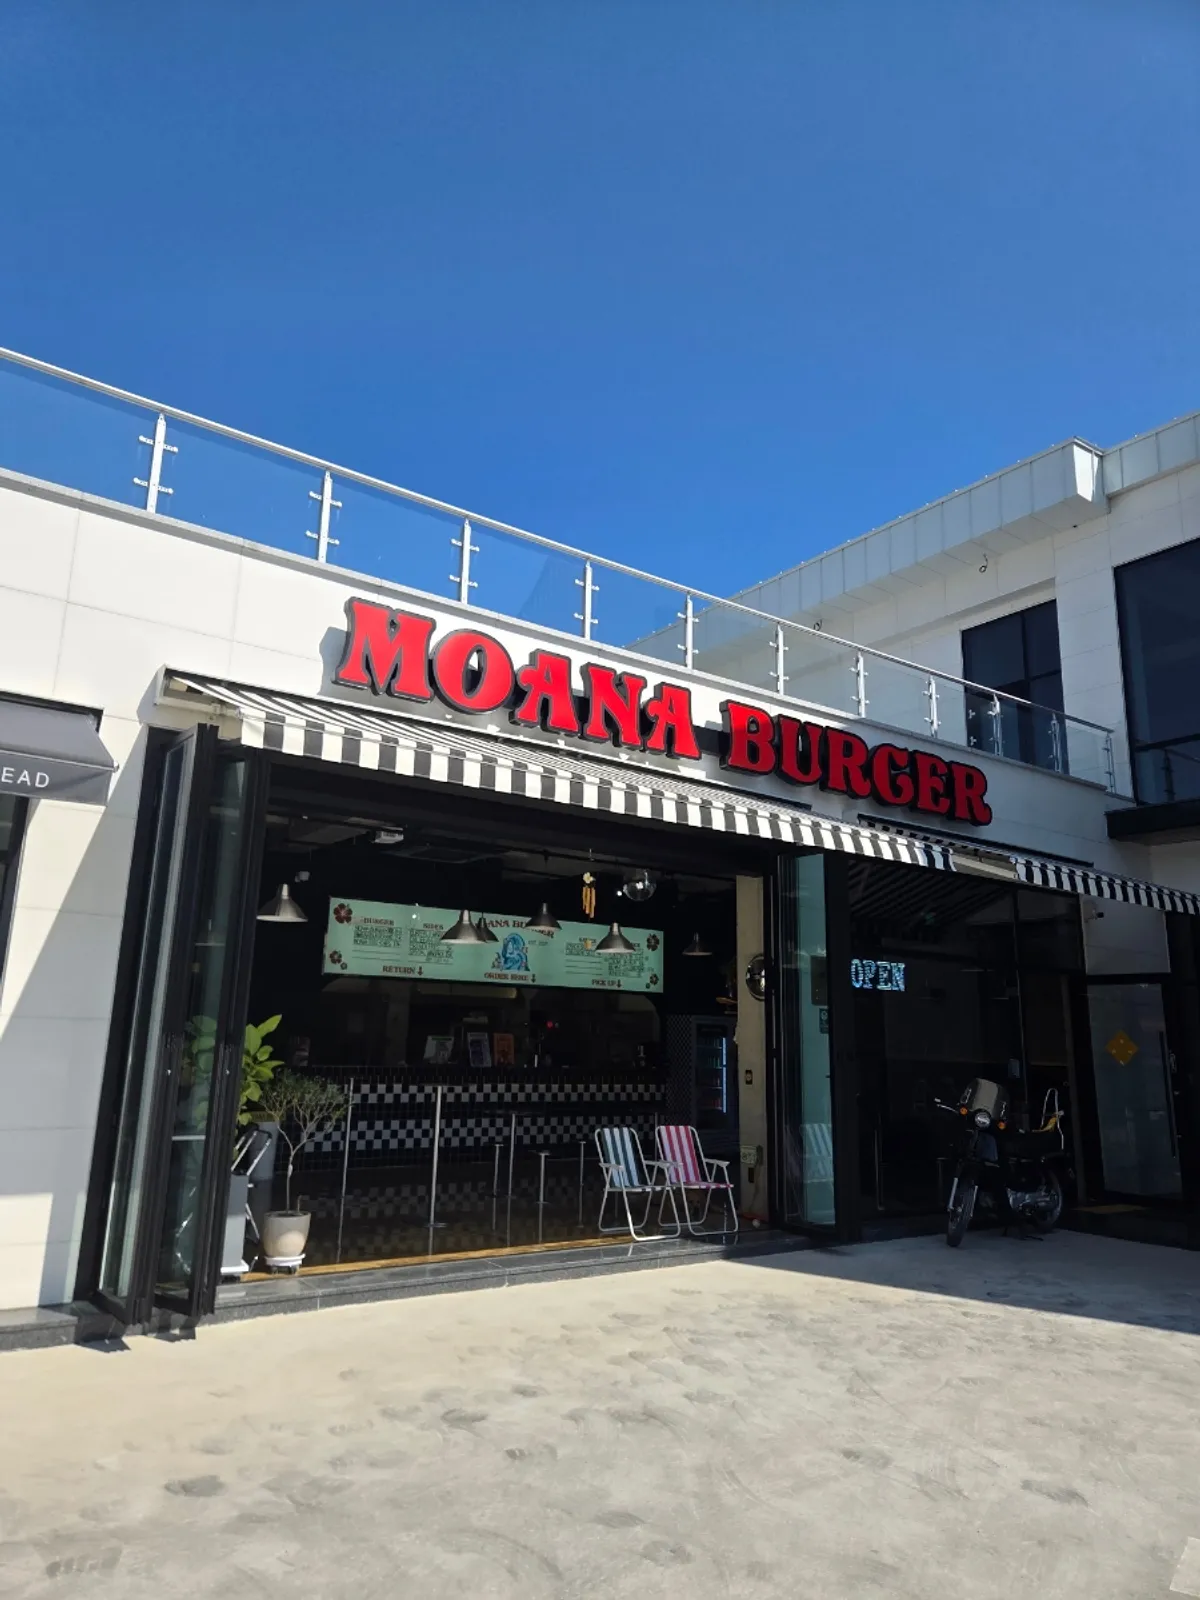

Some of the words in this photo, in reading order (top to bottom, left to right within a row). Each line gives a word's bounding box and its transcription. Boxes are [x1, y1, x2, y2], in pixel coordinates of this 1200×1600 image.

[333, 597, 702, 760] MOANA
[720, 700, 993, 827] BURGER
[1, 766, 50, 788] EAD
[382, 965, 415, 975] RETURN
[851, 959, 906, 992] OPEN
